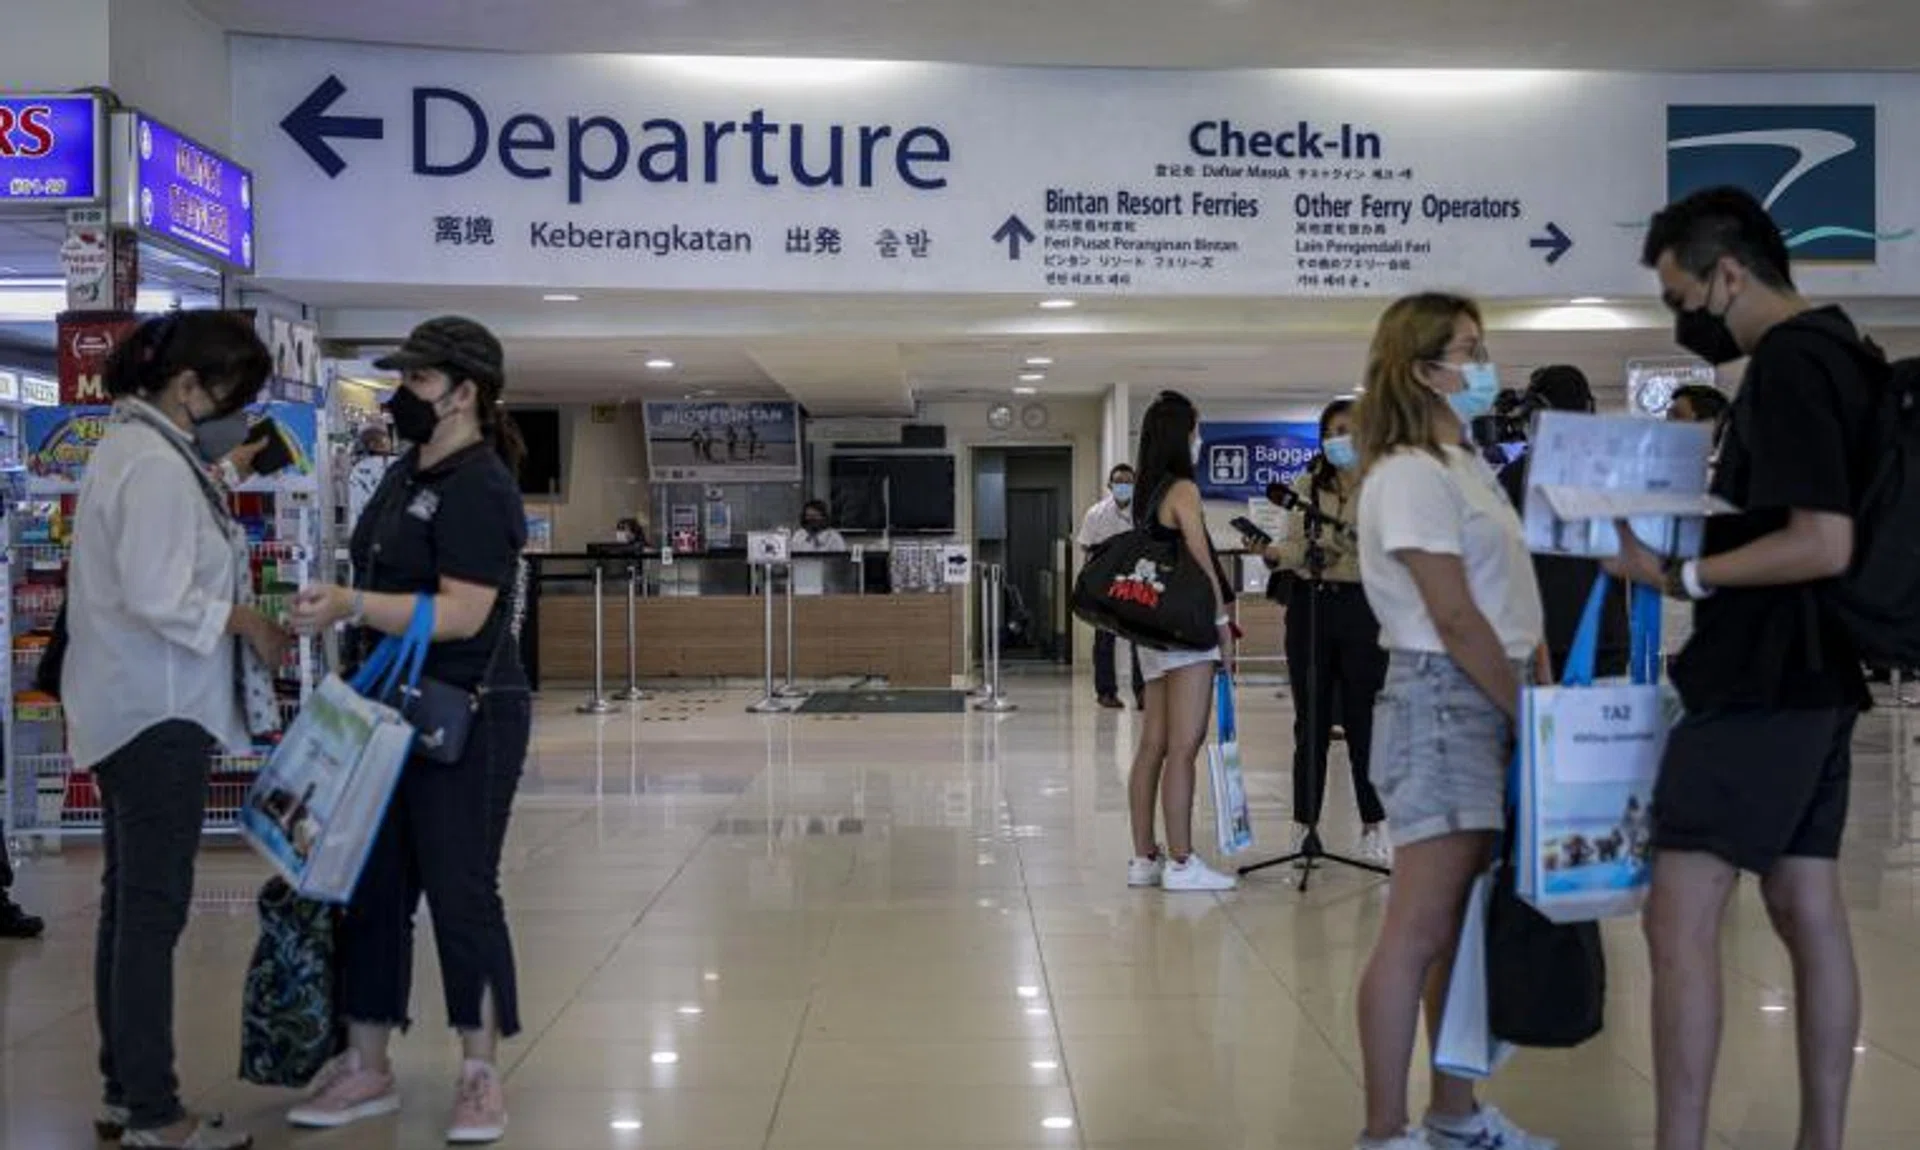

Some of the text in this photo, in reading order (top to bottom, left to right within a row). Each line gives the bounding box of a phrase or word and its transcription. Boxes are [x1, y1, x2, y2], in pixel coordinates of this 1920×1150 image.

[412, 86, 952, 205] Departure
[1188, 119, 1382, 160] Check-In
[1202, 163, 1291, 180] Daftar Masuk
[1045, 189, 1260, 218] Bintan Resort Ferries
[1295, 192, 1522, 224] Other Ferry Operators
[434, 215, 495, 246] 离境
[530, 221, 752, 256] Keberangkatan
[785, 226, 842, 254] 出発
[874, 228, 932, 258] 출발
[1045, 236, 1238, 253] Feri Pusat Peranginan Bintan
[1296, 239, 1431, 256] Lain Pengendali Feri
